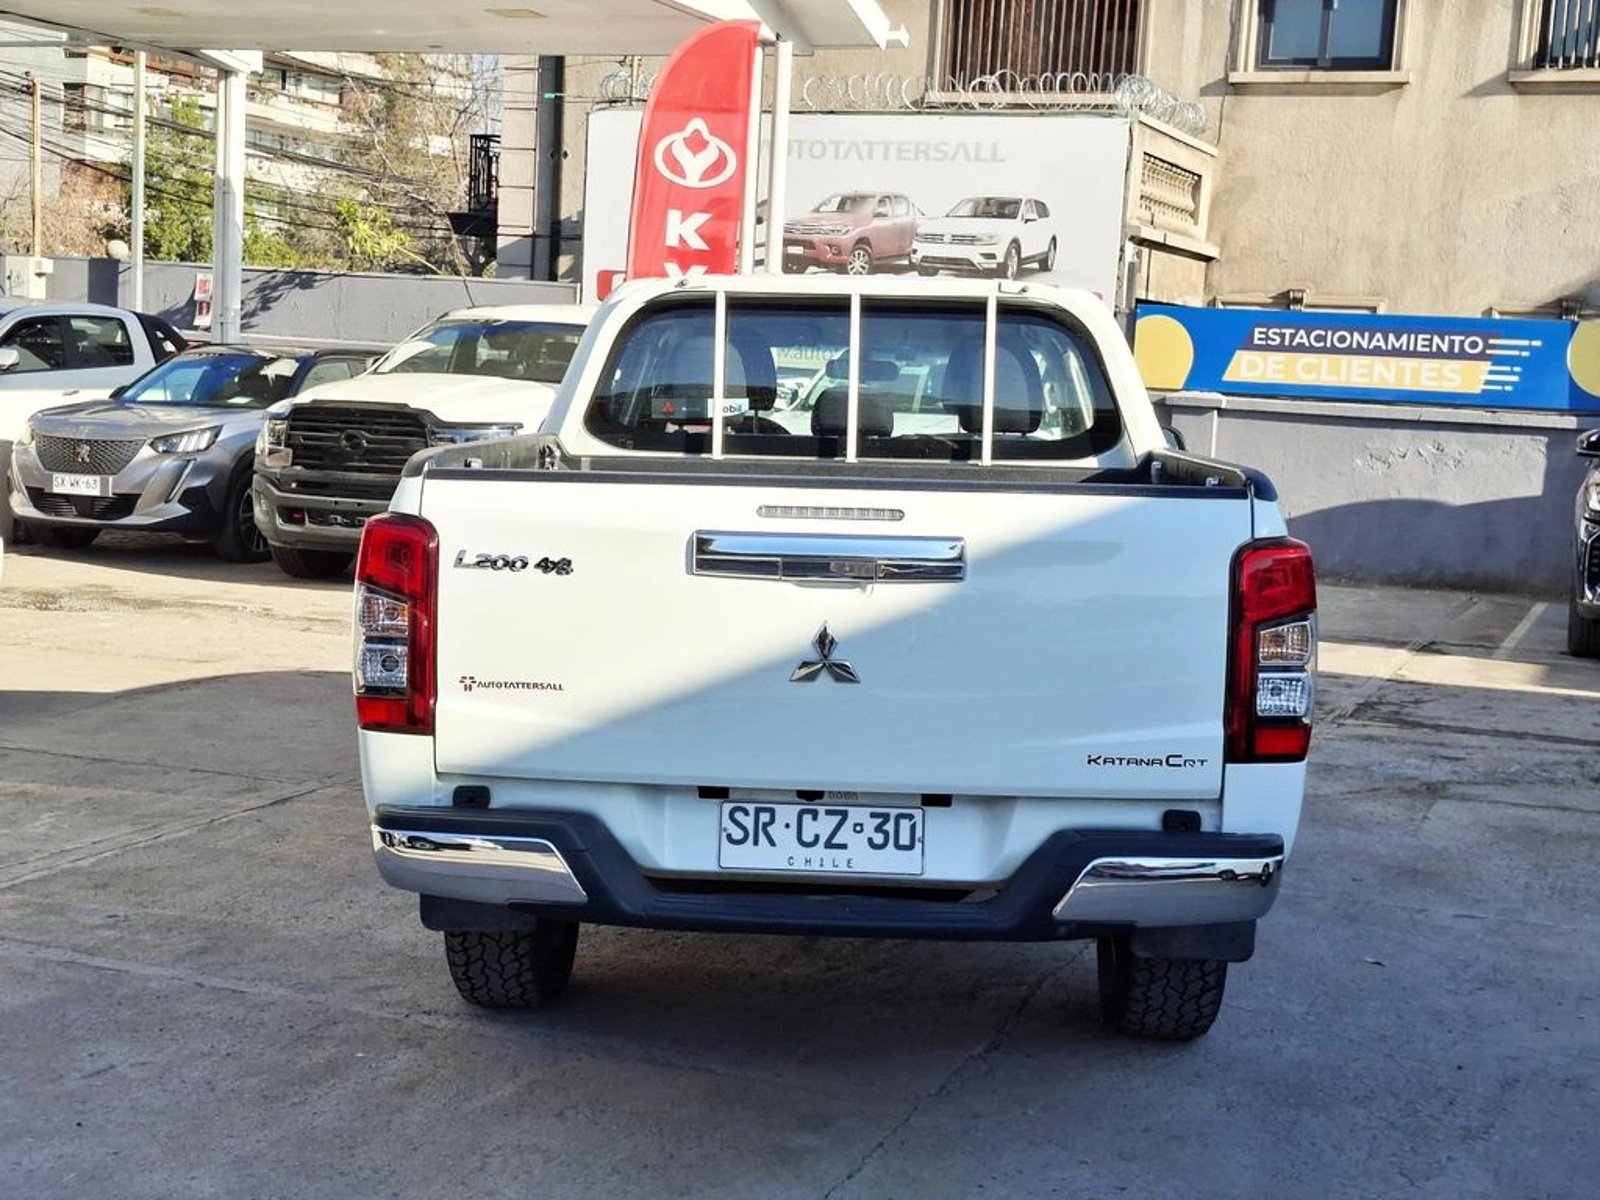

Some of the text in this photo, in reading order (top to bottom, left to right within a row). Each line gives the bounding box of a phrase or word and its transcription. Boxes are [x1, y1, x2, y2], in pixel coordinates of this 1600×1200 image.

[1252, 327, 1484, 354] ESTACIONAMIENTO
[1239, 354, 1462, 388] DE CLIENTES
[453, 549, 529, 572] L200
[477, 681, 564, 691] AUTOTATTERSALL
[787, 856, 854, 869] CHILE
